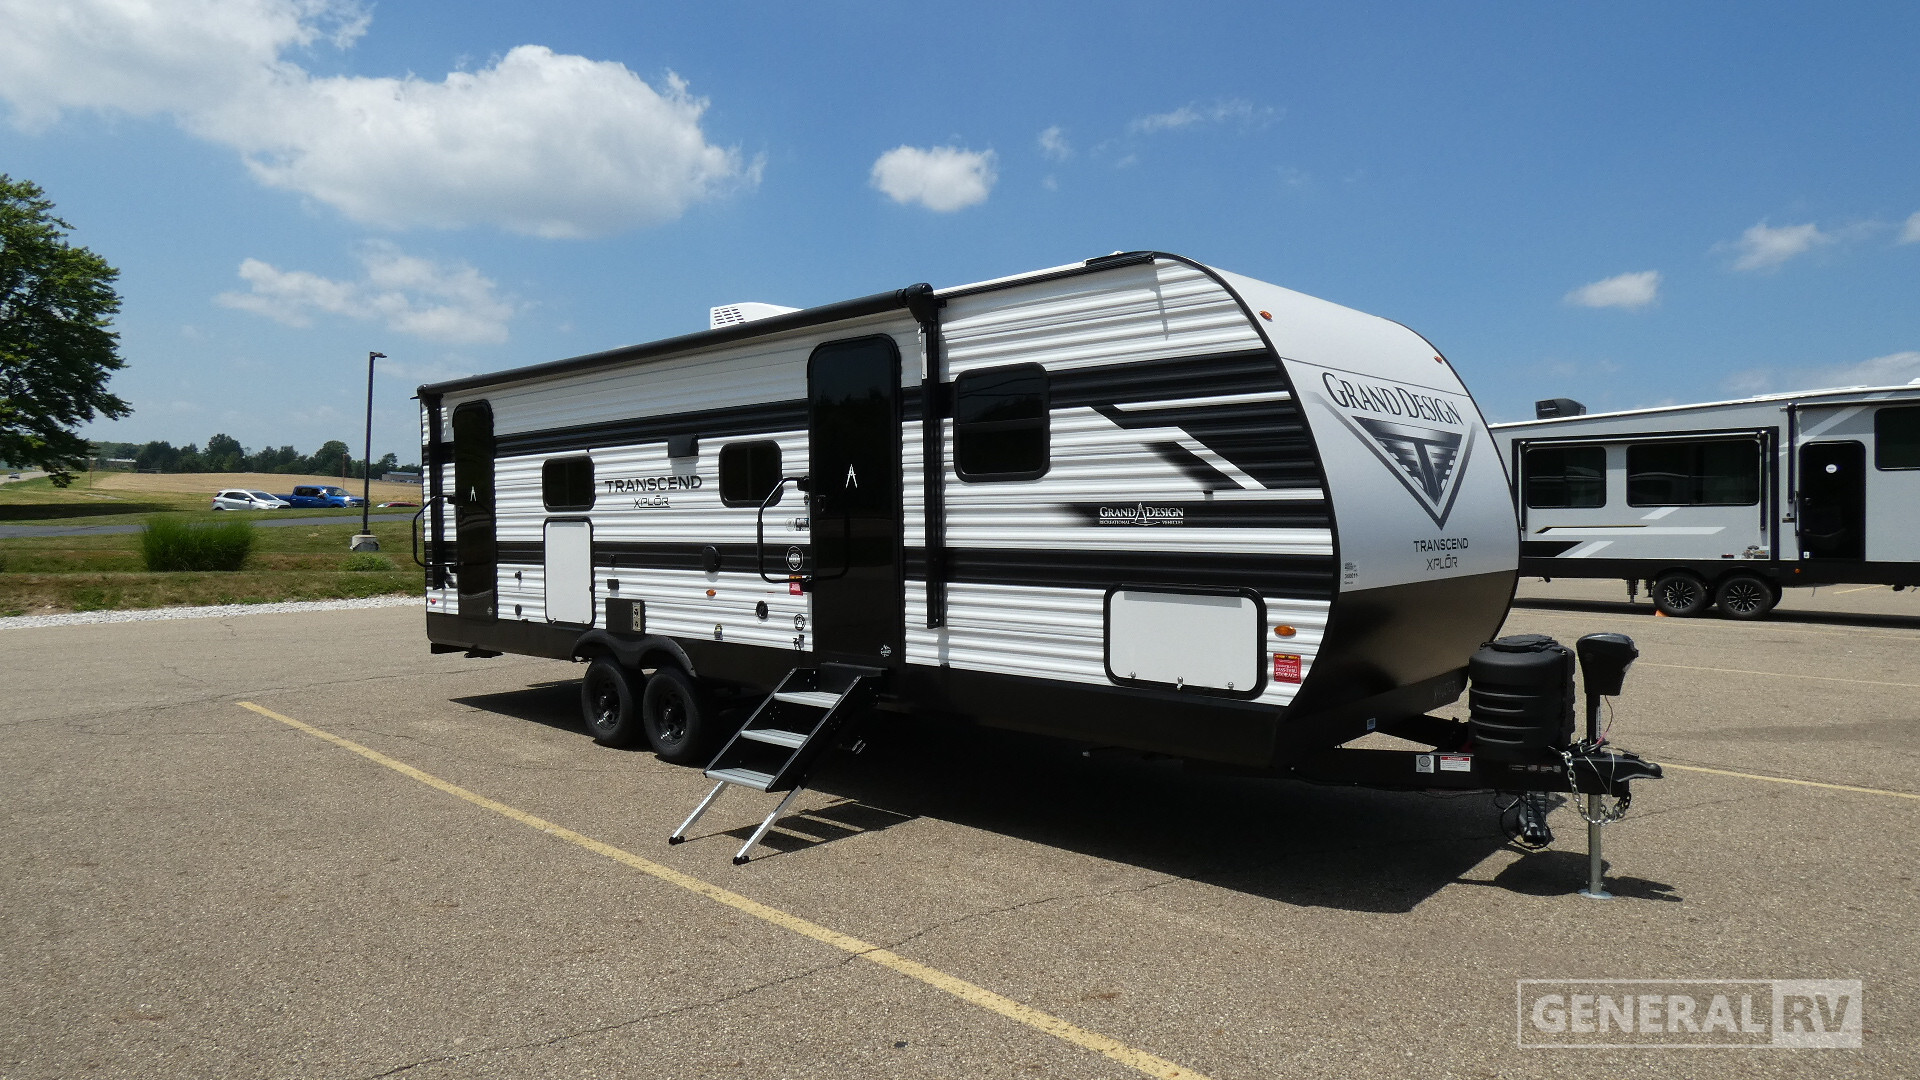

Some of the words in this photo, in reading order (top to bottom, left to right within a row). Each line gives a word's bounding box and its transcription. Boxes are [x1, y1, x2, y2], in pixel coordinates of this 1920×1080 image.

[1321, 371, 1402, 416] GRAND
[1394, 386, 1465, 426] DESIGN
[604, 475, 703, 493] TRANSCEND
[1099, 506, 1136, 518] GRAND
[1145, 506, 1184, 518] DESIGN
[1413, 537, 1469, 553] TRANSCEND
